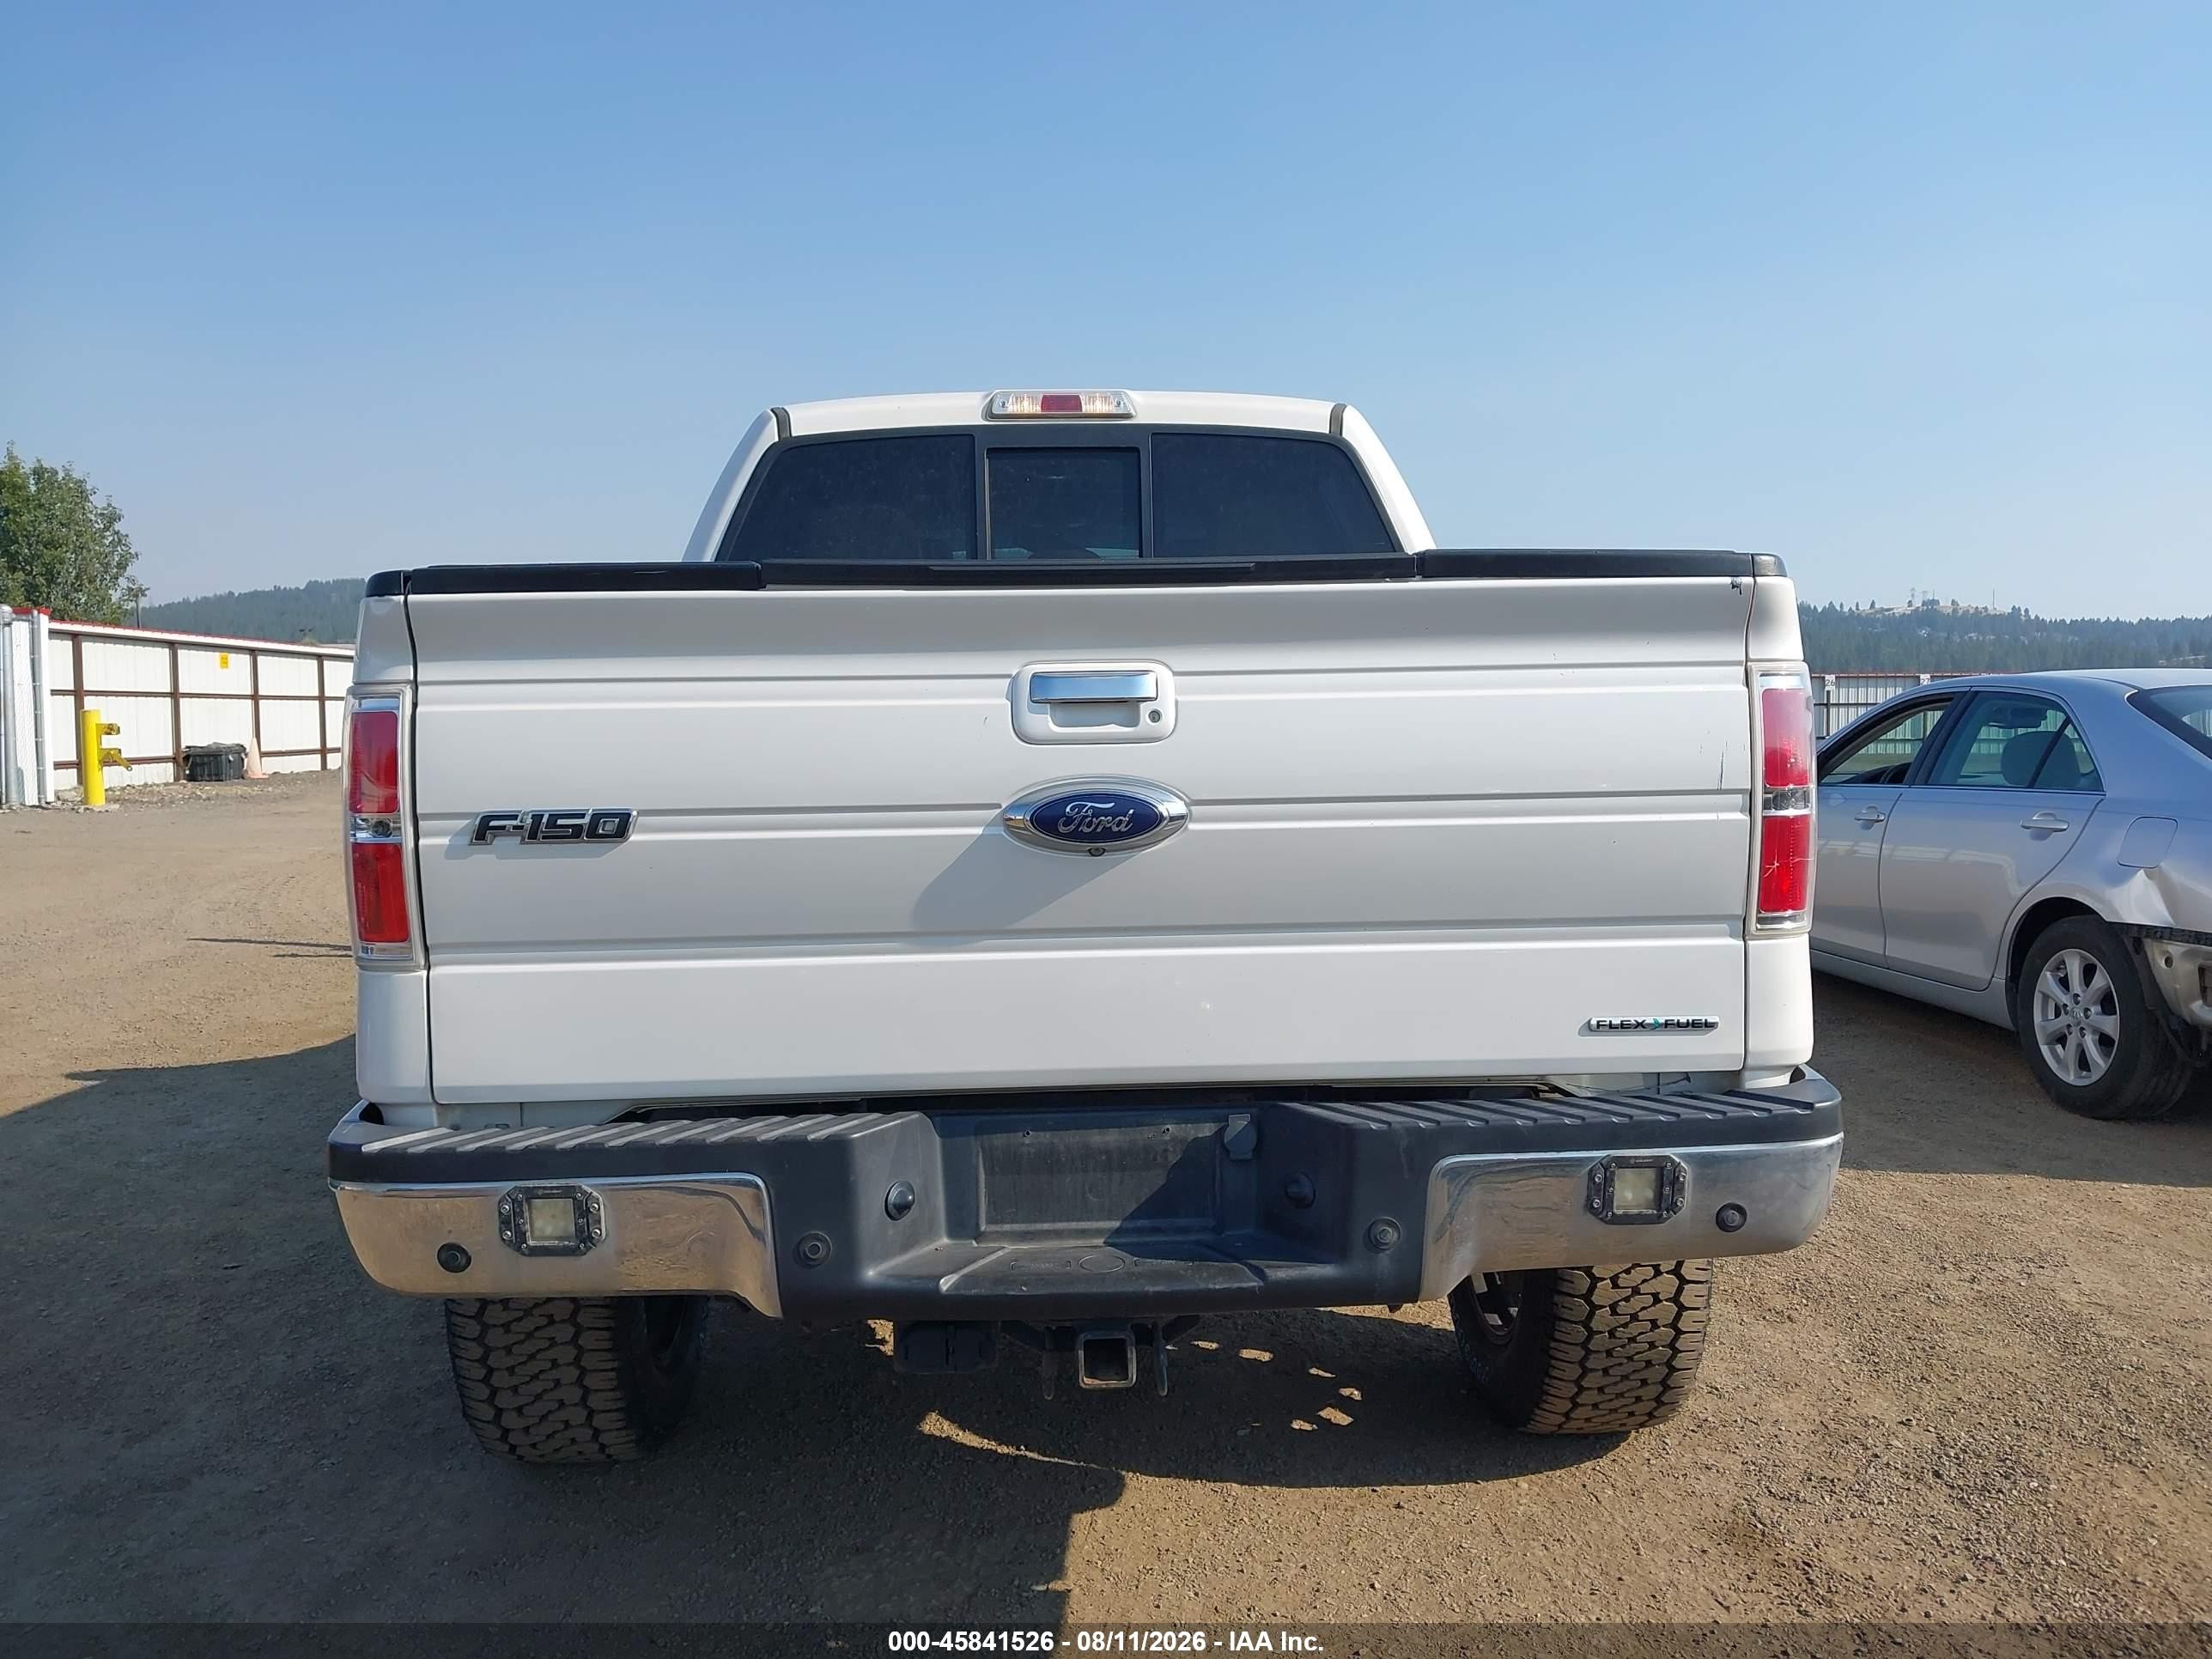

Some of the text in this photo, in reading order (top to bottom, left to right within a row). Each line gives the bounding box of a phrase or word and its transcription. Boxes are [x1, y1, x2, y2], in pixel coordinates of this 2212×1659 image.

[1825, 678, 1836, 687] 26
[470, 809, 636, 845] F-150
[1057, 800, 1136, 834] Ford
[1595, 1018, 1716, 1030] FLEX FUEL
